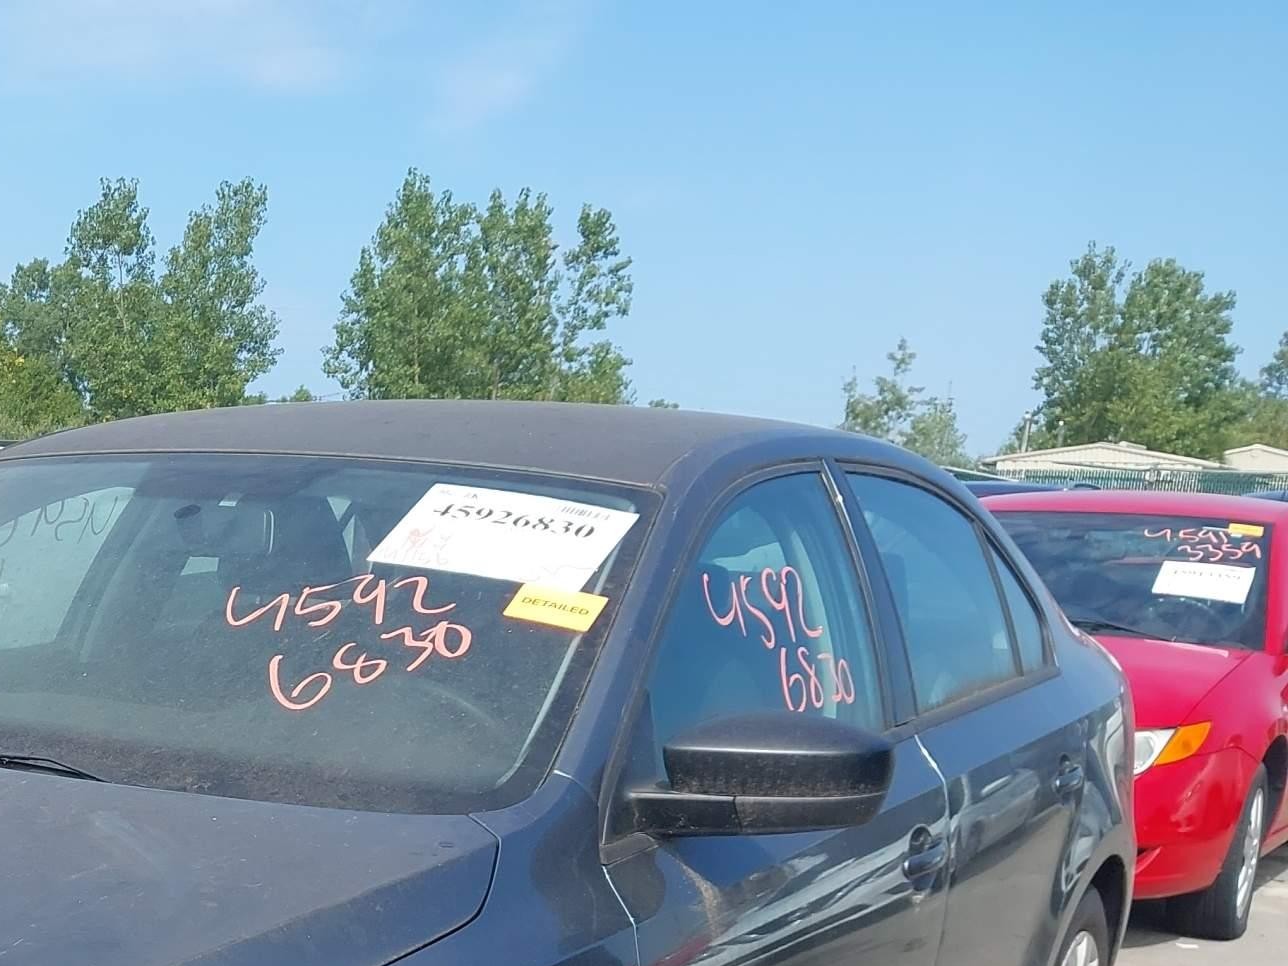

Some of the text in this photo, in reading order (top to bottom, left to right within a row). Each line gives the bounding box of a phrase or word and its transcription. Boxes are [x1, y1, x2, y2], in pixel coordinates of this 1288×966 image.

[432, 503, 596, 539] 45926830
[225, 573, 457, 632] 4592
[520, 595, 591, 616] DETAILED
[701, 565, 824, 650] 4592
[268, 620, 473, 711] 6830
